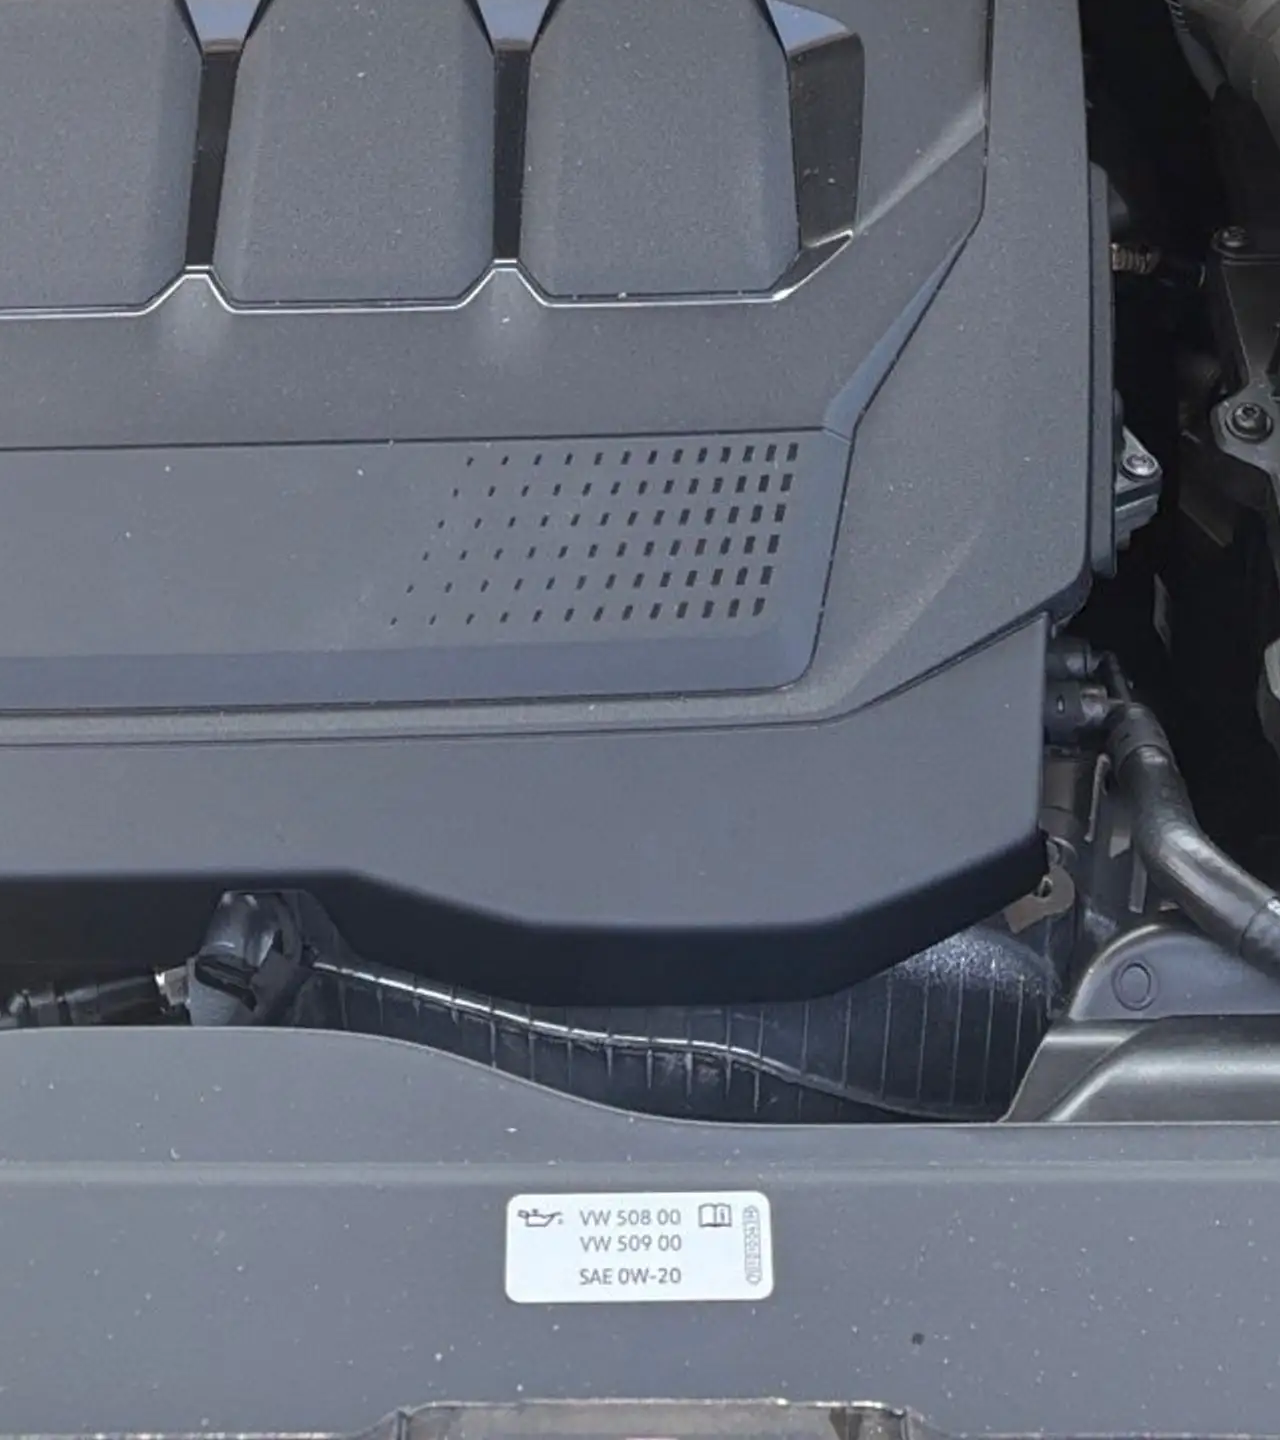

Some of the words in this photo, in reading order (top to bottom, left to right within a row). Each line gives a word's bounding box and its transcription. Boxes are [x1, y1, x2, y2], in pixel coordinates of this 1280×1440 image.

[579, 1209, 611, 1227] VW
[616, 1209, 652, 1227] 508
[657, 1208, 682, 1227] 00
[579, 1236, 612, 1253] VW
[616, 1235, 653, 1252] 509
[657, 1234, 683, 1252] 00
[579, 1268, 613, 1286] SAE
[618, 1267, 683, 1285] 0W-20
